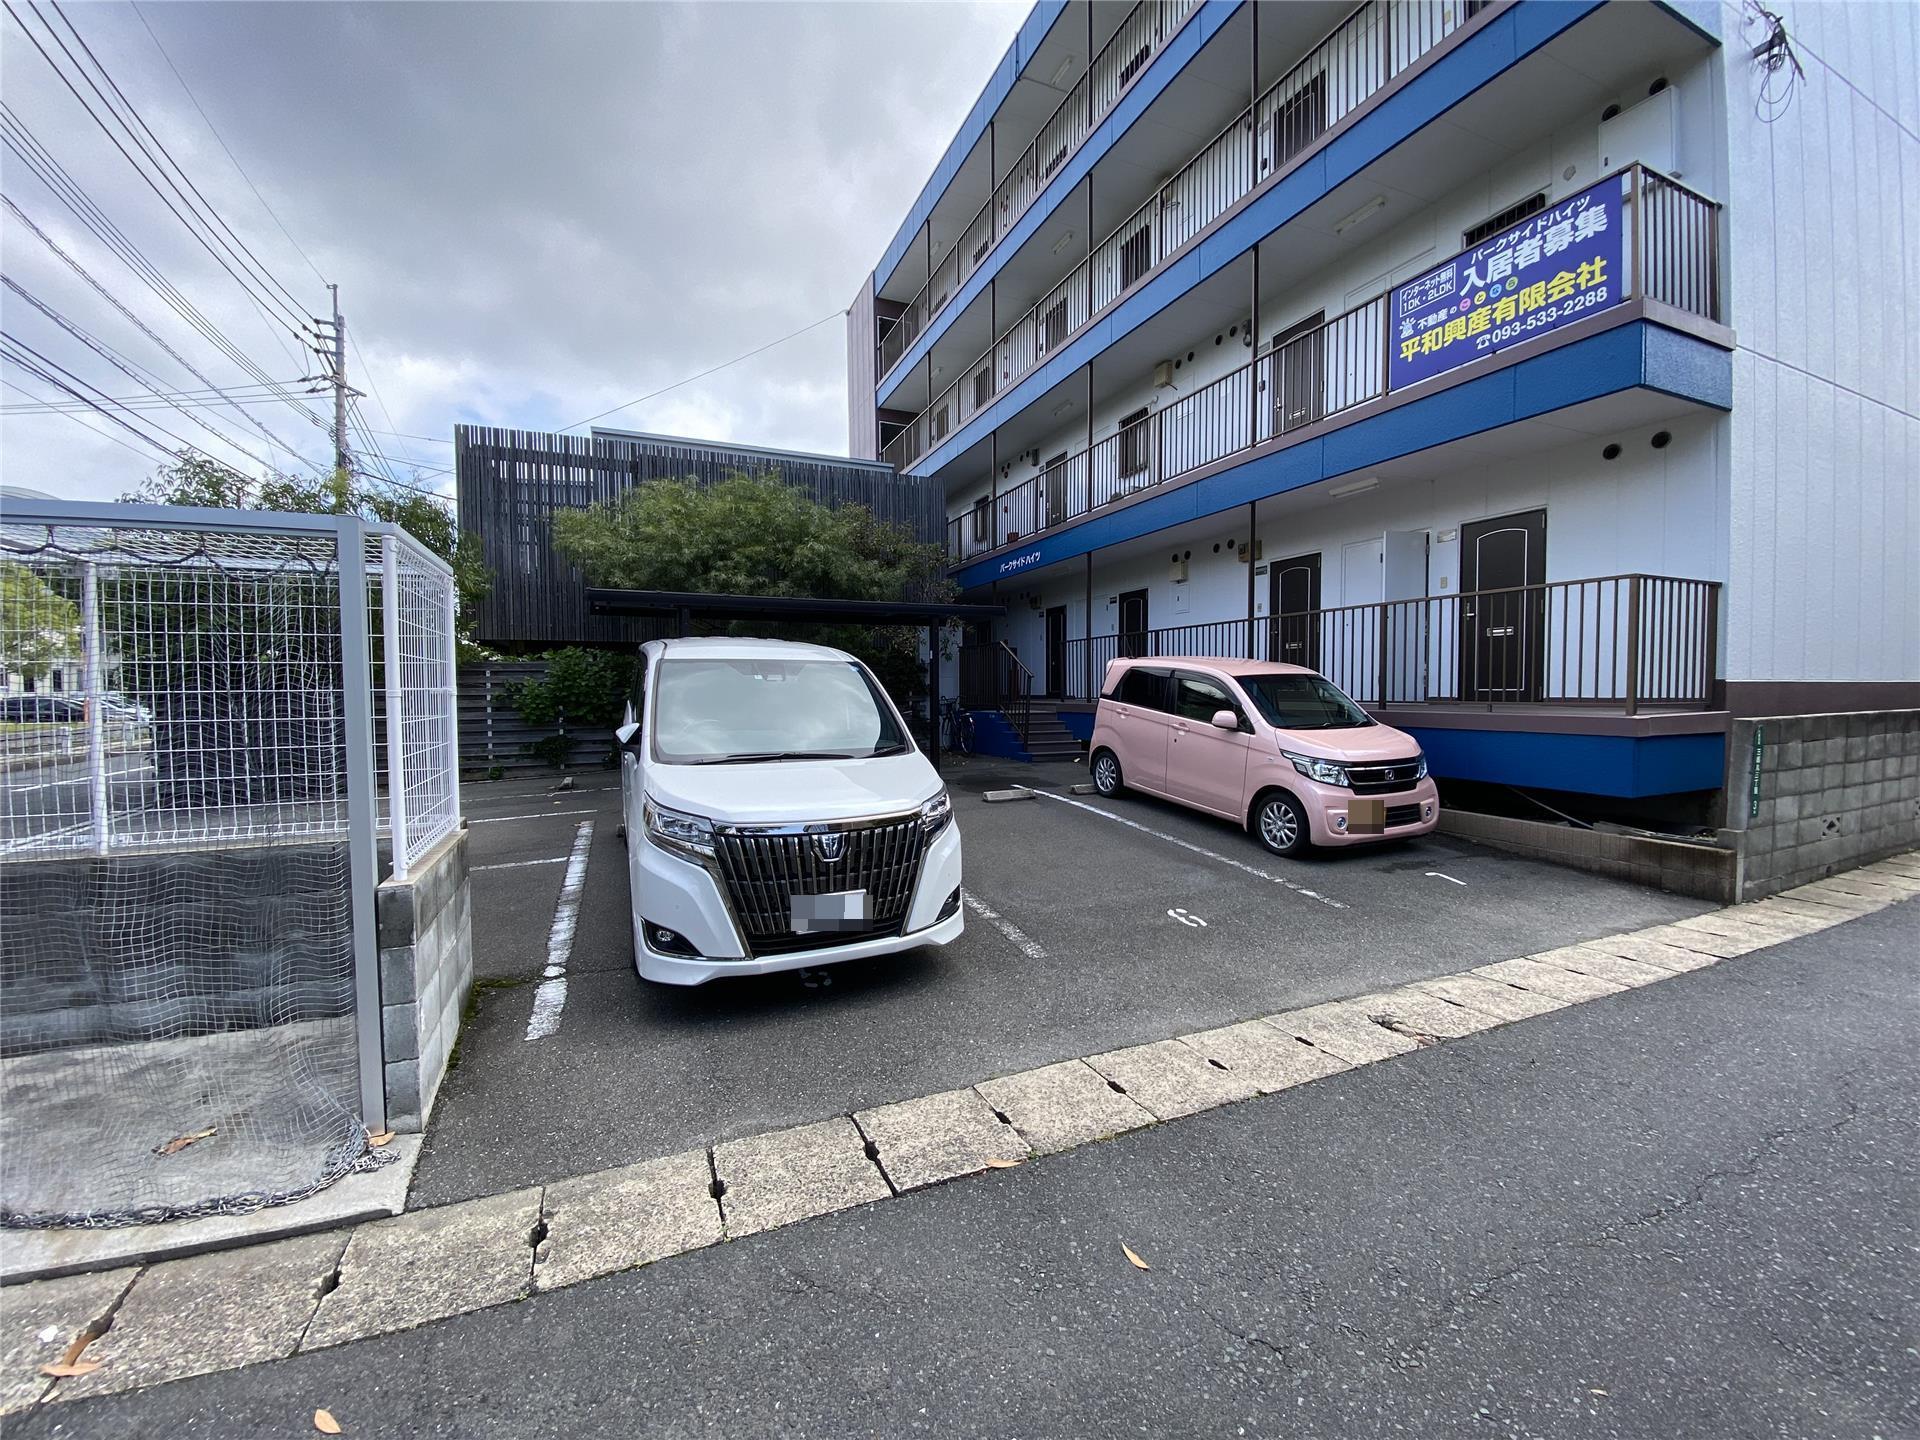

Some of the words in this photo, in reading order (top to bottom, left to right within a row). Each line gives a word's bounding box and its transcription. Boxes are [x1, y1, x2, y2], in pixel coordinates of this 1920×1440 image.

[1460, 204, 1608, 297] 入居者募集
[1470, 195, 1591, 264] パークサイドハイツ
[1399, 256, 1608, 363] 平和興産有限会社
[1491, 286, 1608, 344] 093-533-2288
